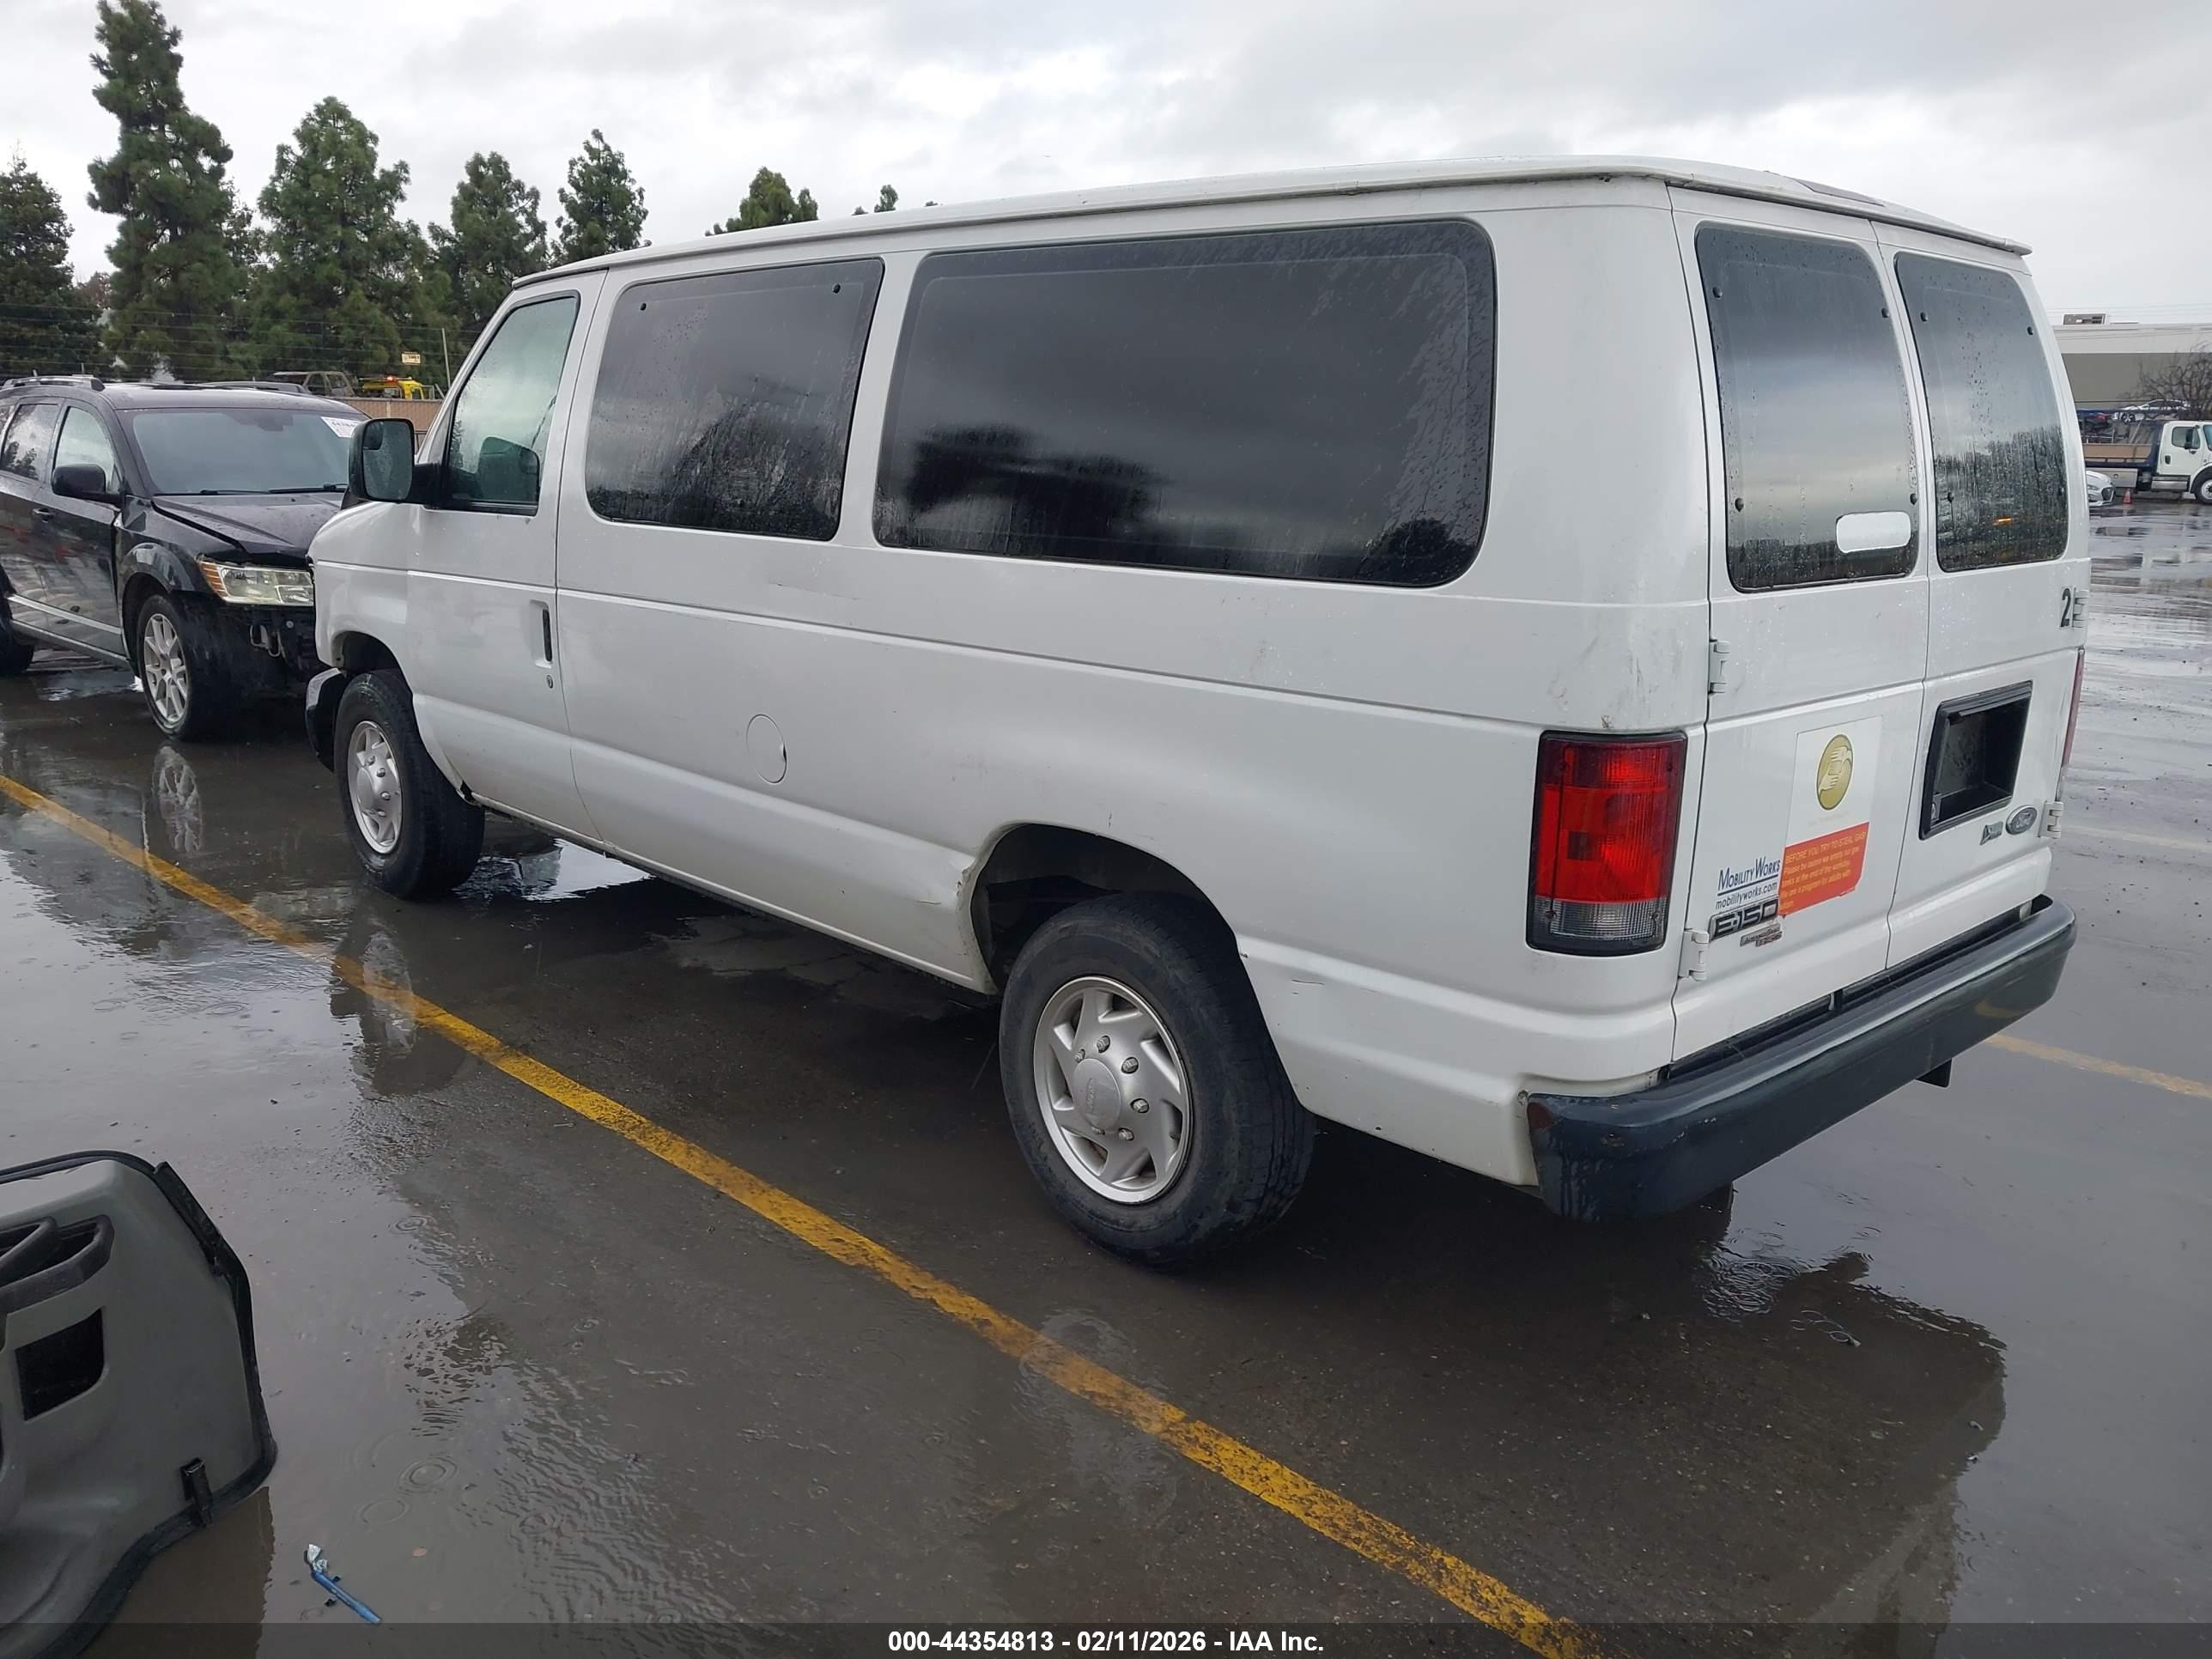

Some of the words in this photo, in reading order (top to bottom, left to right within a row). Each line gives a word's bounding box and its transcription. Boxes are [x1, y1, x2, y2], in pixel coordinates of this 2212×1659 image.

[1784, 848, 1808, 864] BEFORE
[1808, 844, 1820, 857] YOU
[1820, 841, 1831, 853] TRY
[1716, 882, 1778, 909] mobilityworks.com
[1714, 898, 1778, 939] E-150
